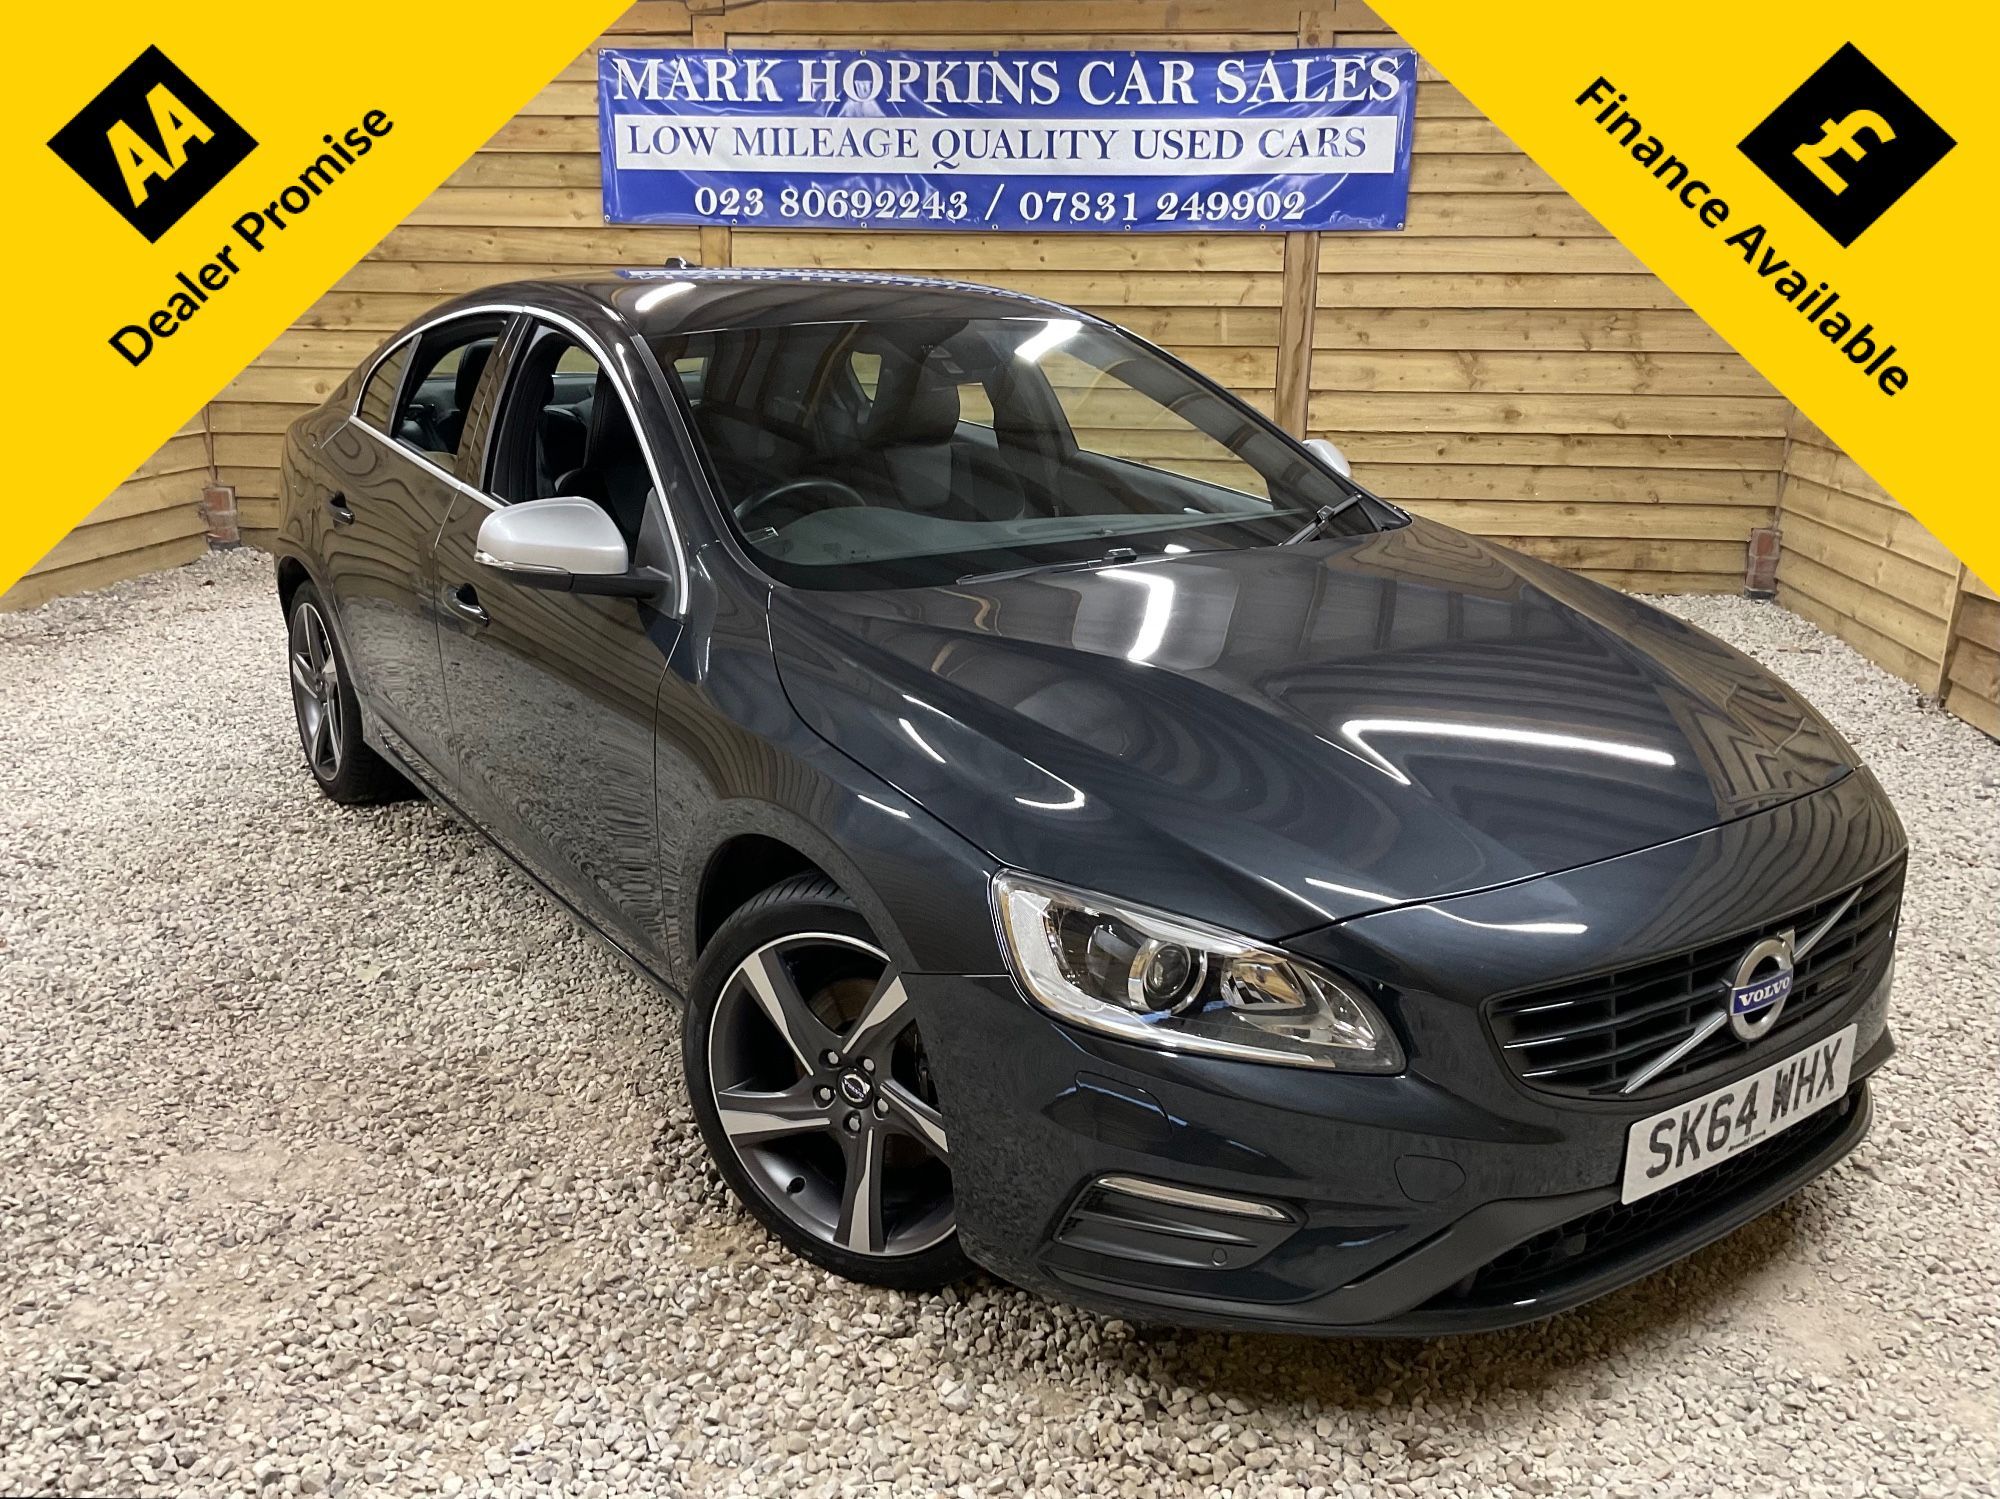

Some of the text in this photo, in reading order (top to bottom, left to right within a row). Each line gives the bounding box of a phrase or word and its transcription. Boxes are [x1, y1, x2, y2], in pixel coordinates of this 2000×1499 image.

[613, 57, 1400, 105] MARK HOPKINS CAR SALES
[628, 125, 1366, 170] LOW MILEAGE QUALITY USED CARS
[695, 184, 1305, 221] 023 80692243 / 07831 249902
[1739, 976, 1790, 1007] VOLVO
[1645, 1037, 1843, 1179] SK64 WHX
